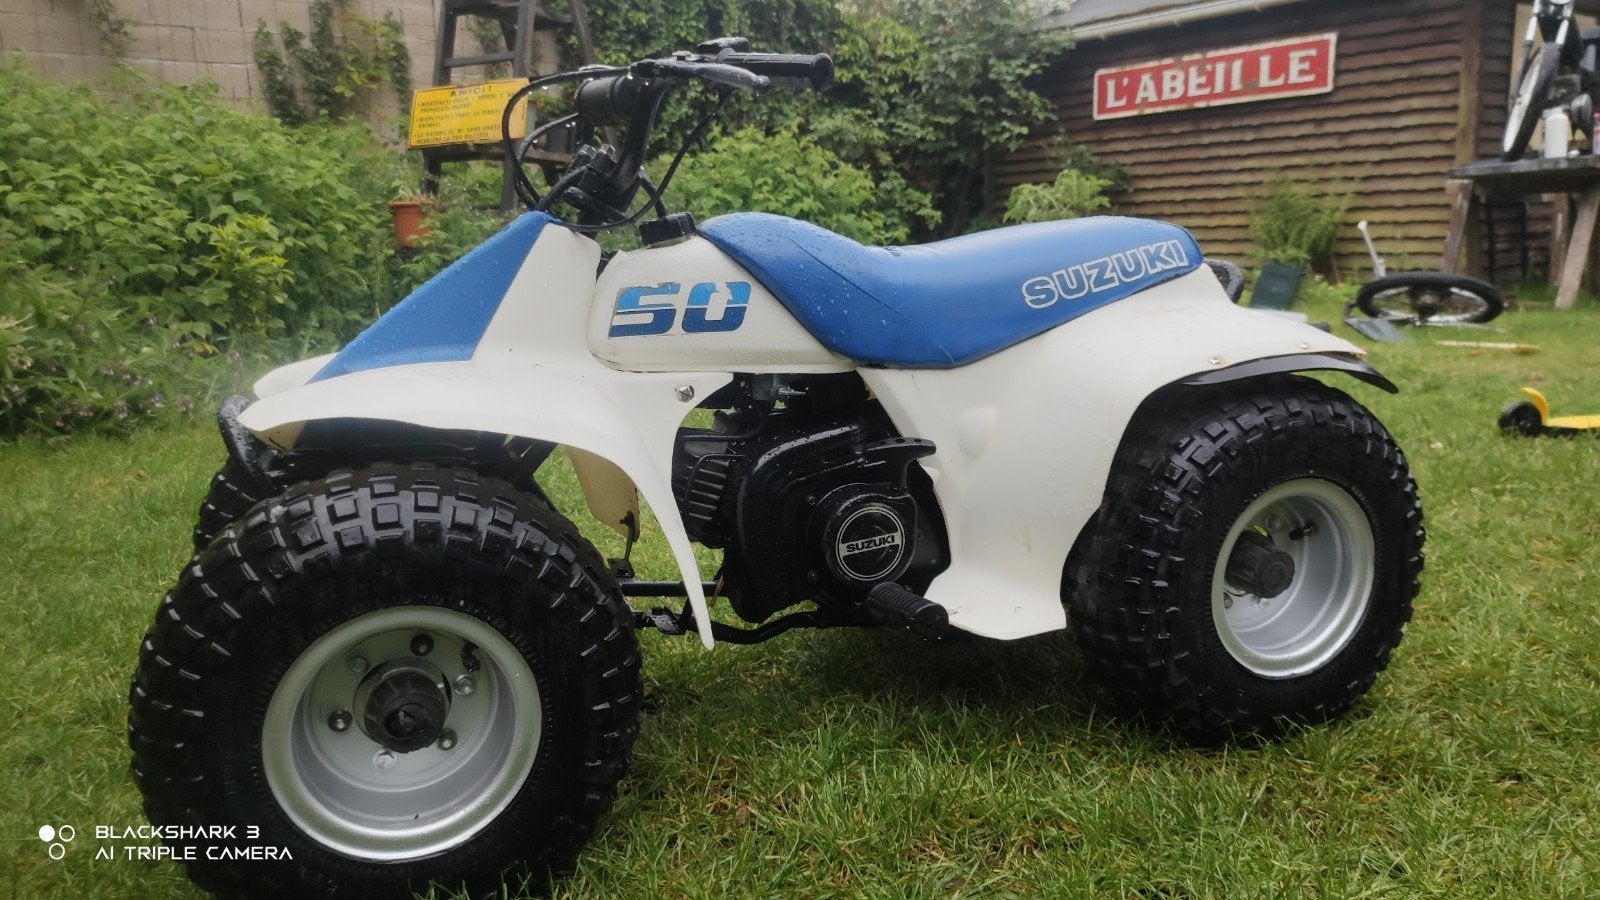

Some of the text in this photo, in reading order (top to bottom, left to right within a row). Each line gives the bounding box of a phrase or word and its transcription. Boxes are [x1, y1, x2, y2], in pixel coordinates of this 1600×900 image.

[450, 85, 491, 97] AMICI!
[1022, 240, 1189, 309] SUZUKI
[608, 281, 752, 338] 50
[846, 535, 895, 553] SUZUKI
